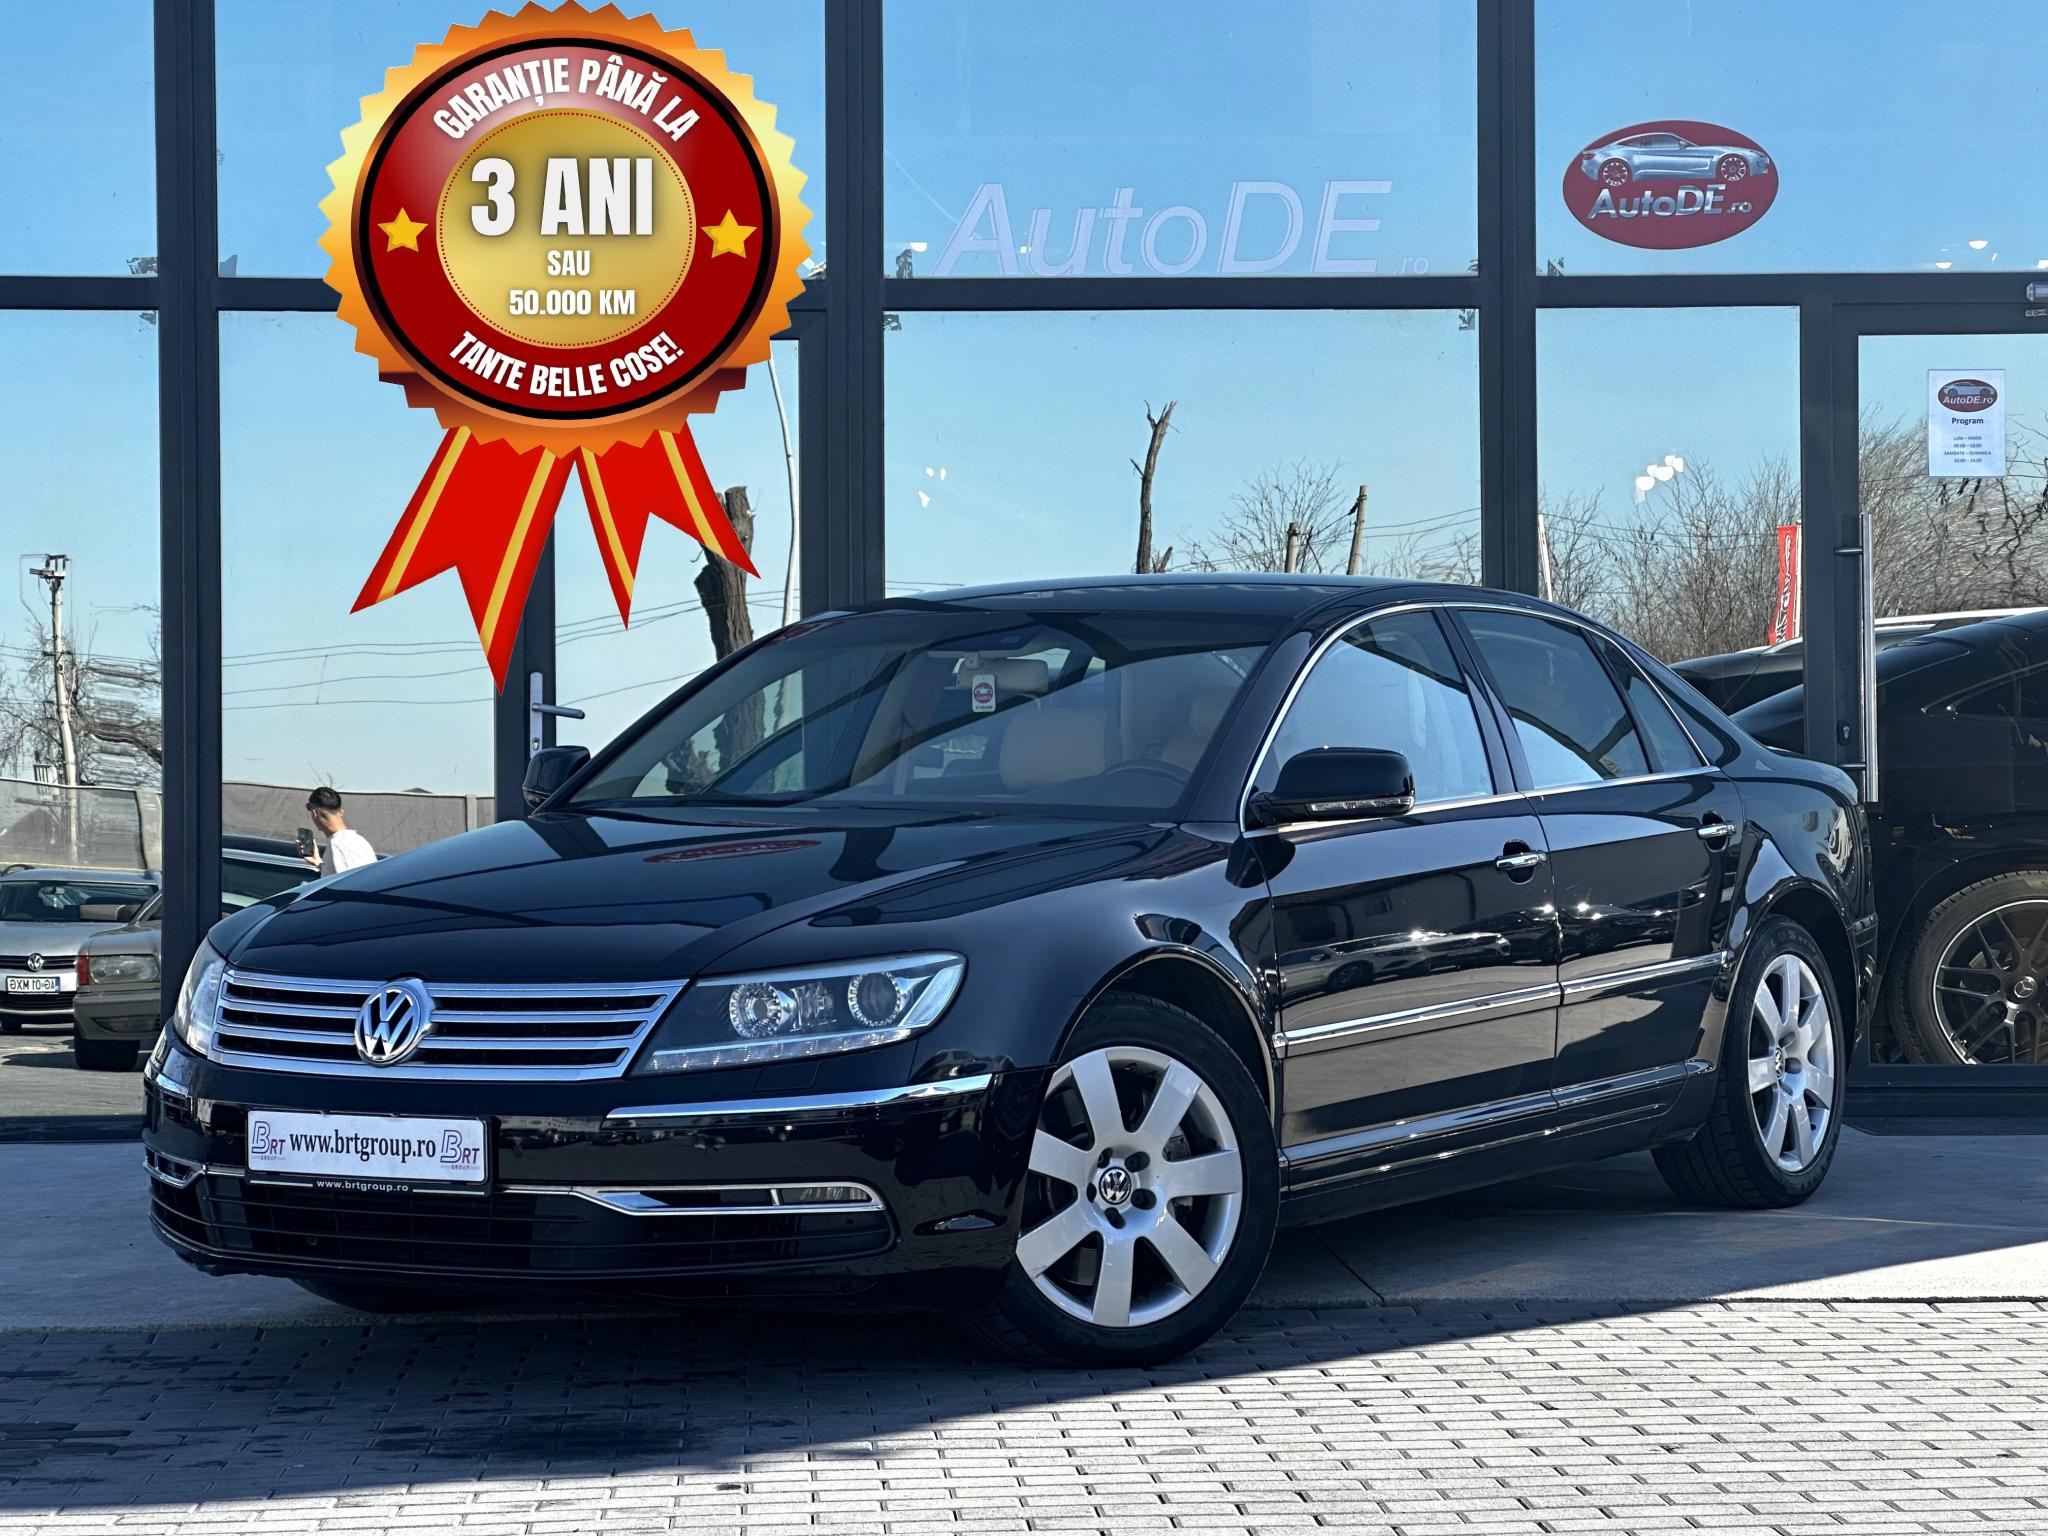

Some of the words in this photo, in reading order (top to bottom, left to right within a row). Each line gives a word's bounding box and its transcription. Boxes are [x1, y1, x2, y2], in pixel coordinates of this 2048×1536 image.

[1942, 395, 1994, 405] AutoDE.ro
[1951, 417, 1984, 425] Program
[289, 1129, 437, 1164] www.brtgroup.ro
[316, 1179, 410, 1193] www.brtgroup.ro
